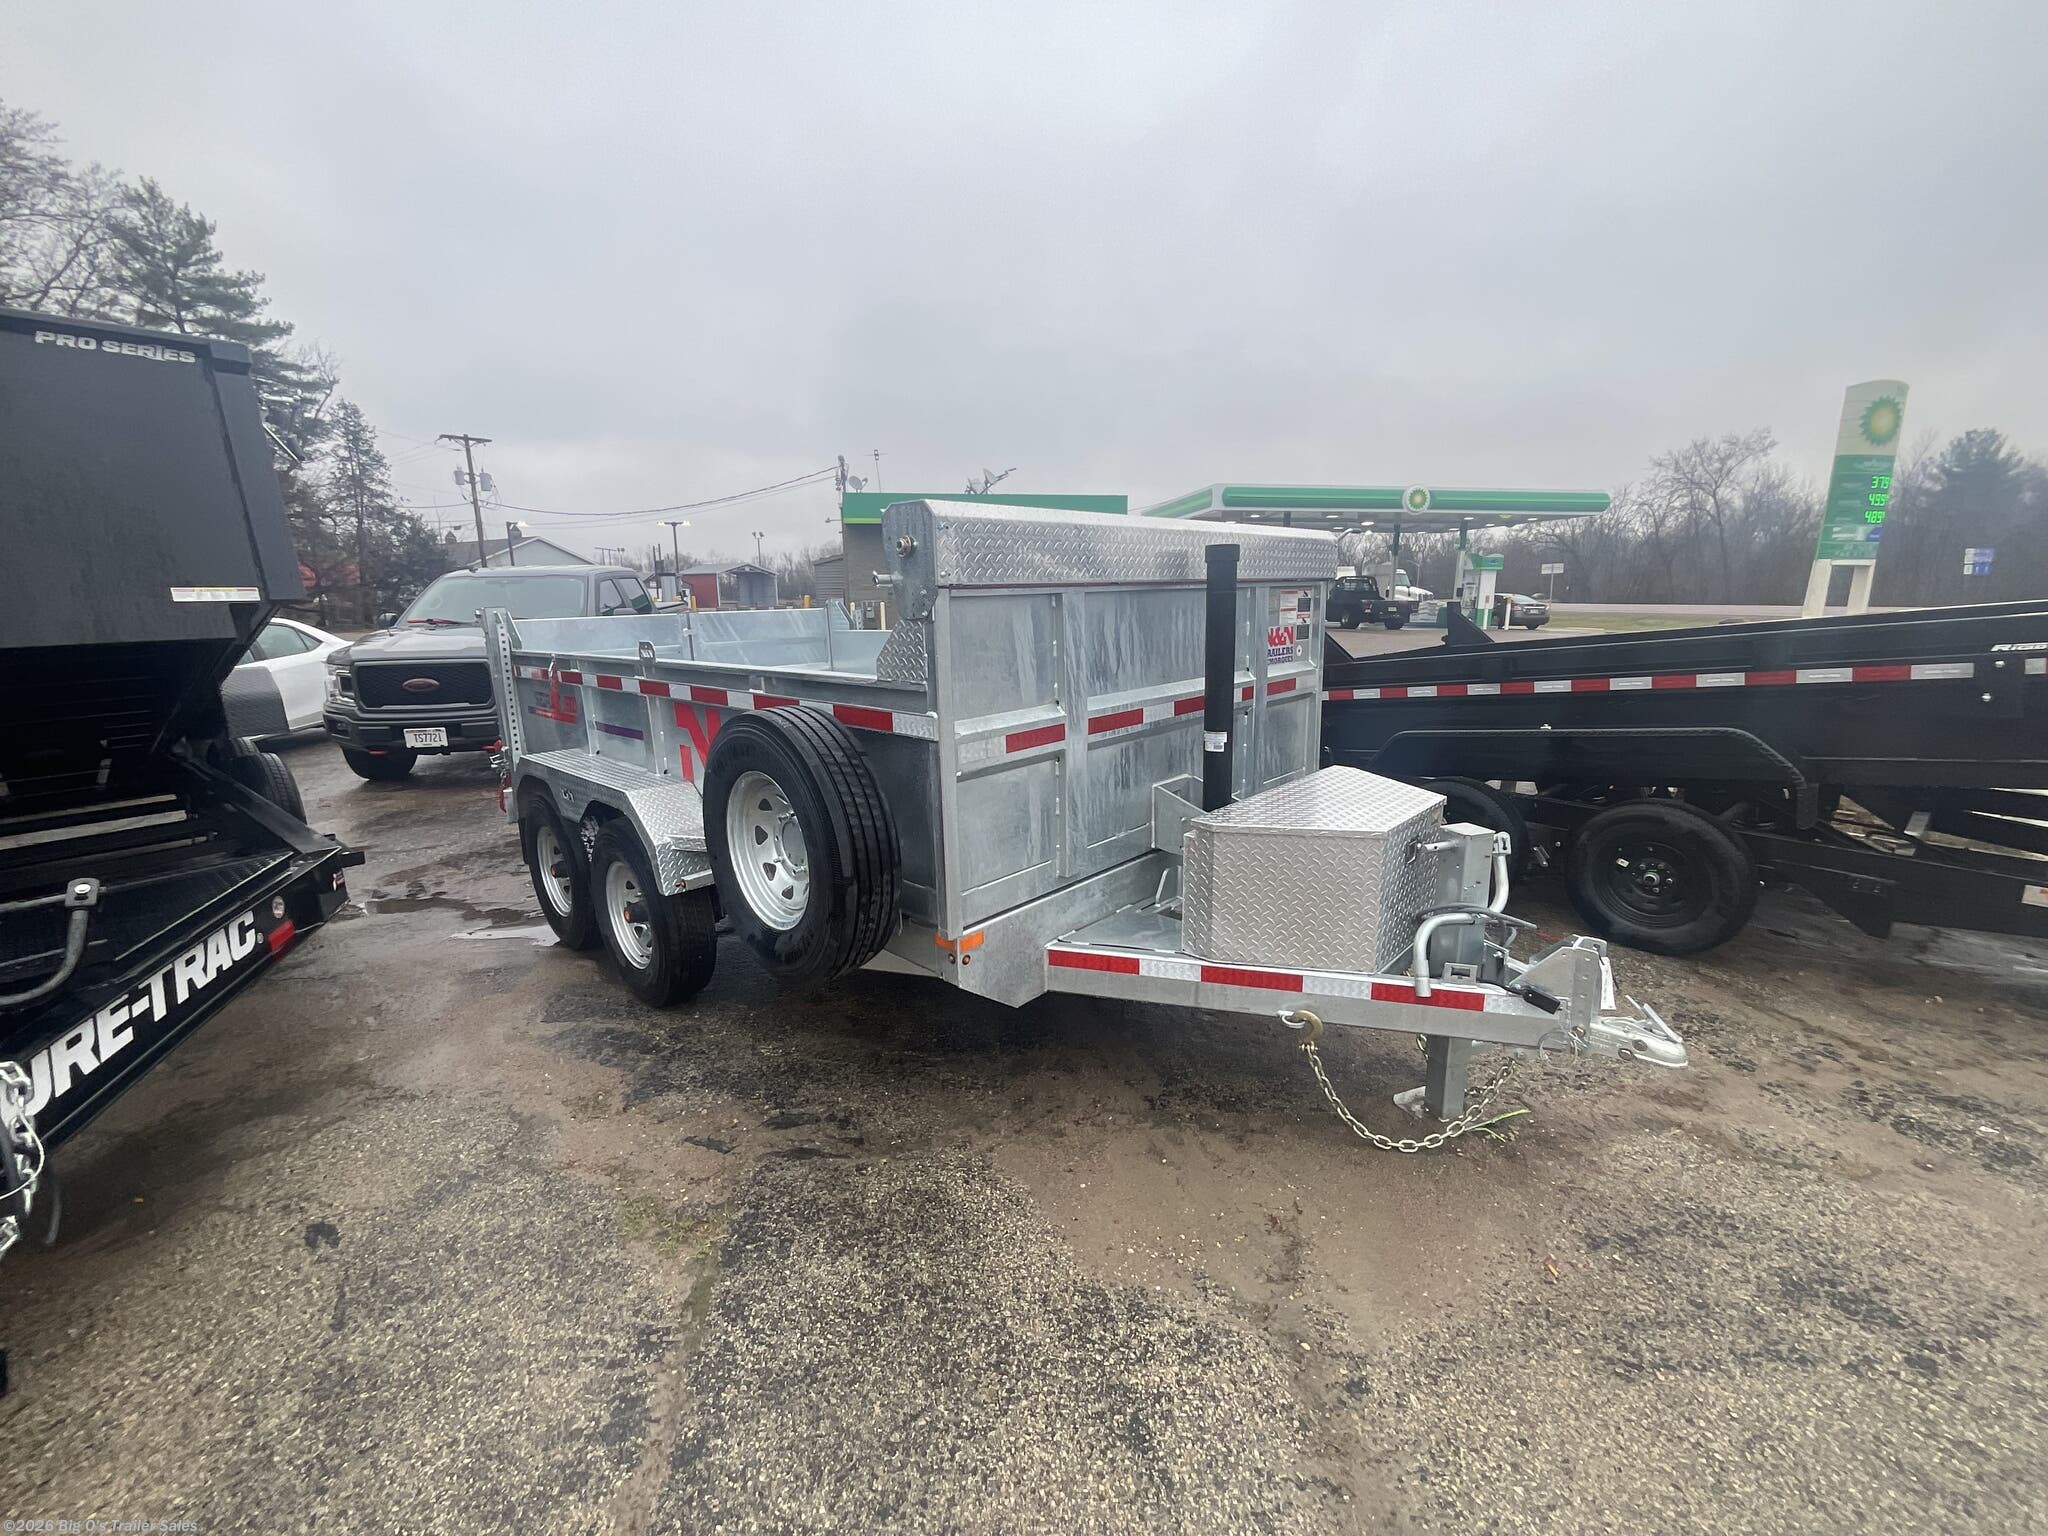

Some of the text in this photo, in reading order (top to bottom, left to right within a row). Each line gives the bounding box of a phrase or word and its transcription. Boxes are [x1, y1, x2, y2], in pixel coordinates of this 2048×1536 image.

[34, 331, 197, 364] PRO SERIES
[1267, 647, 1294, 656] RAILERS
